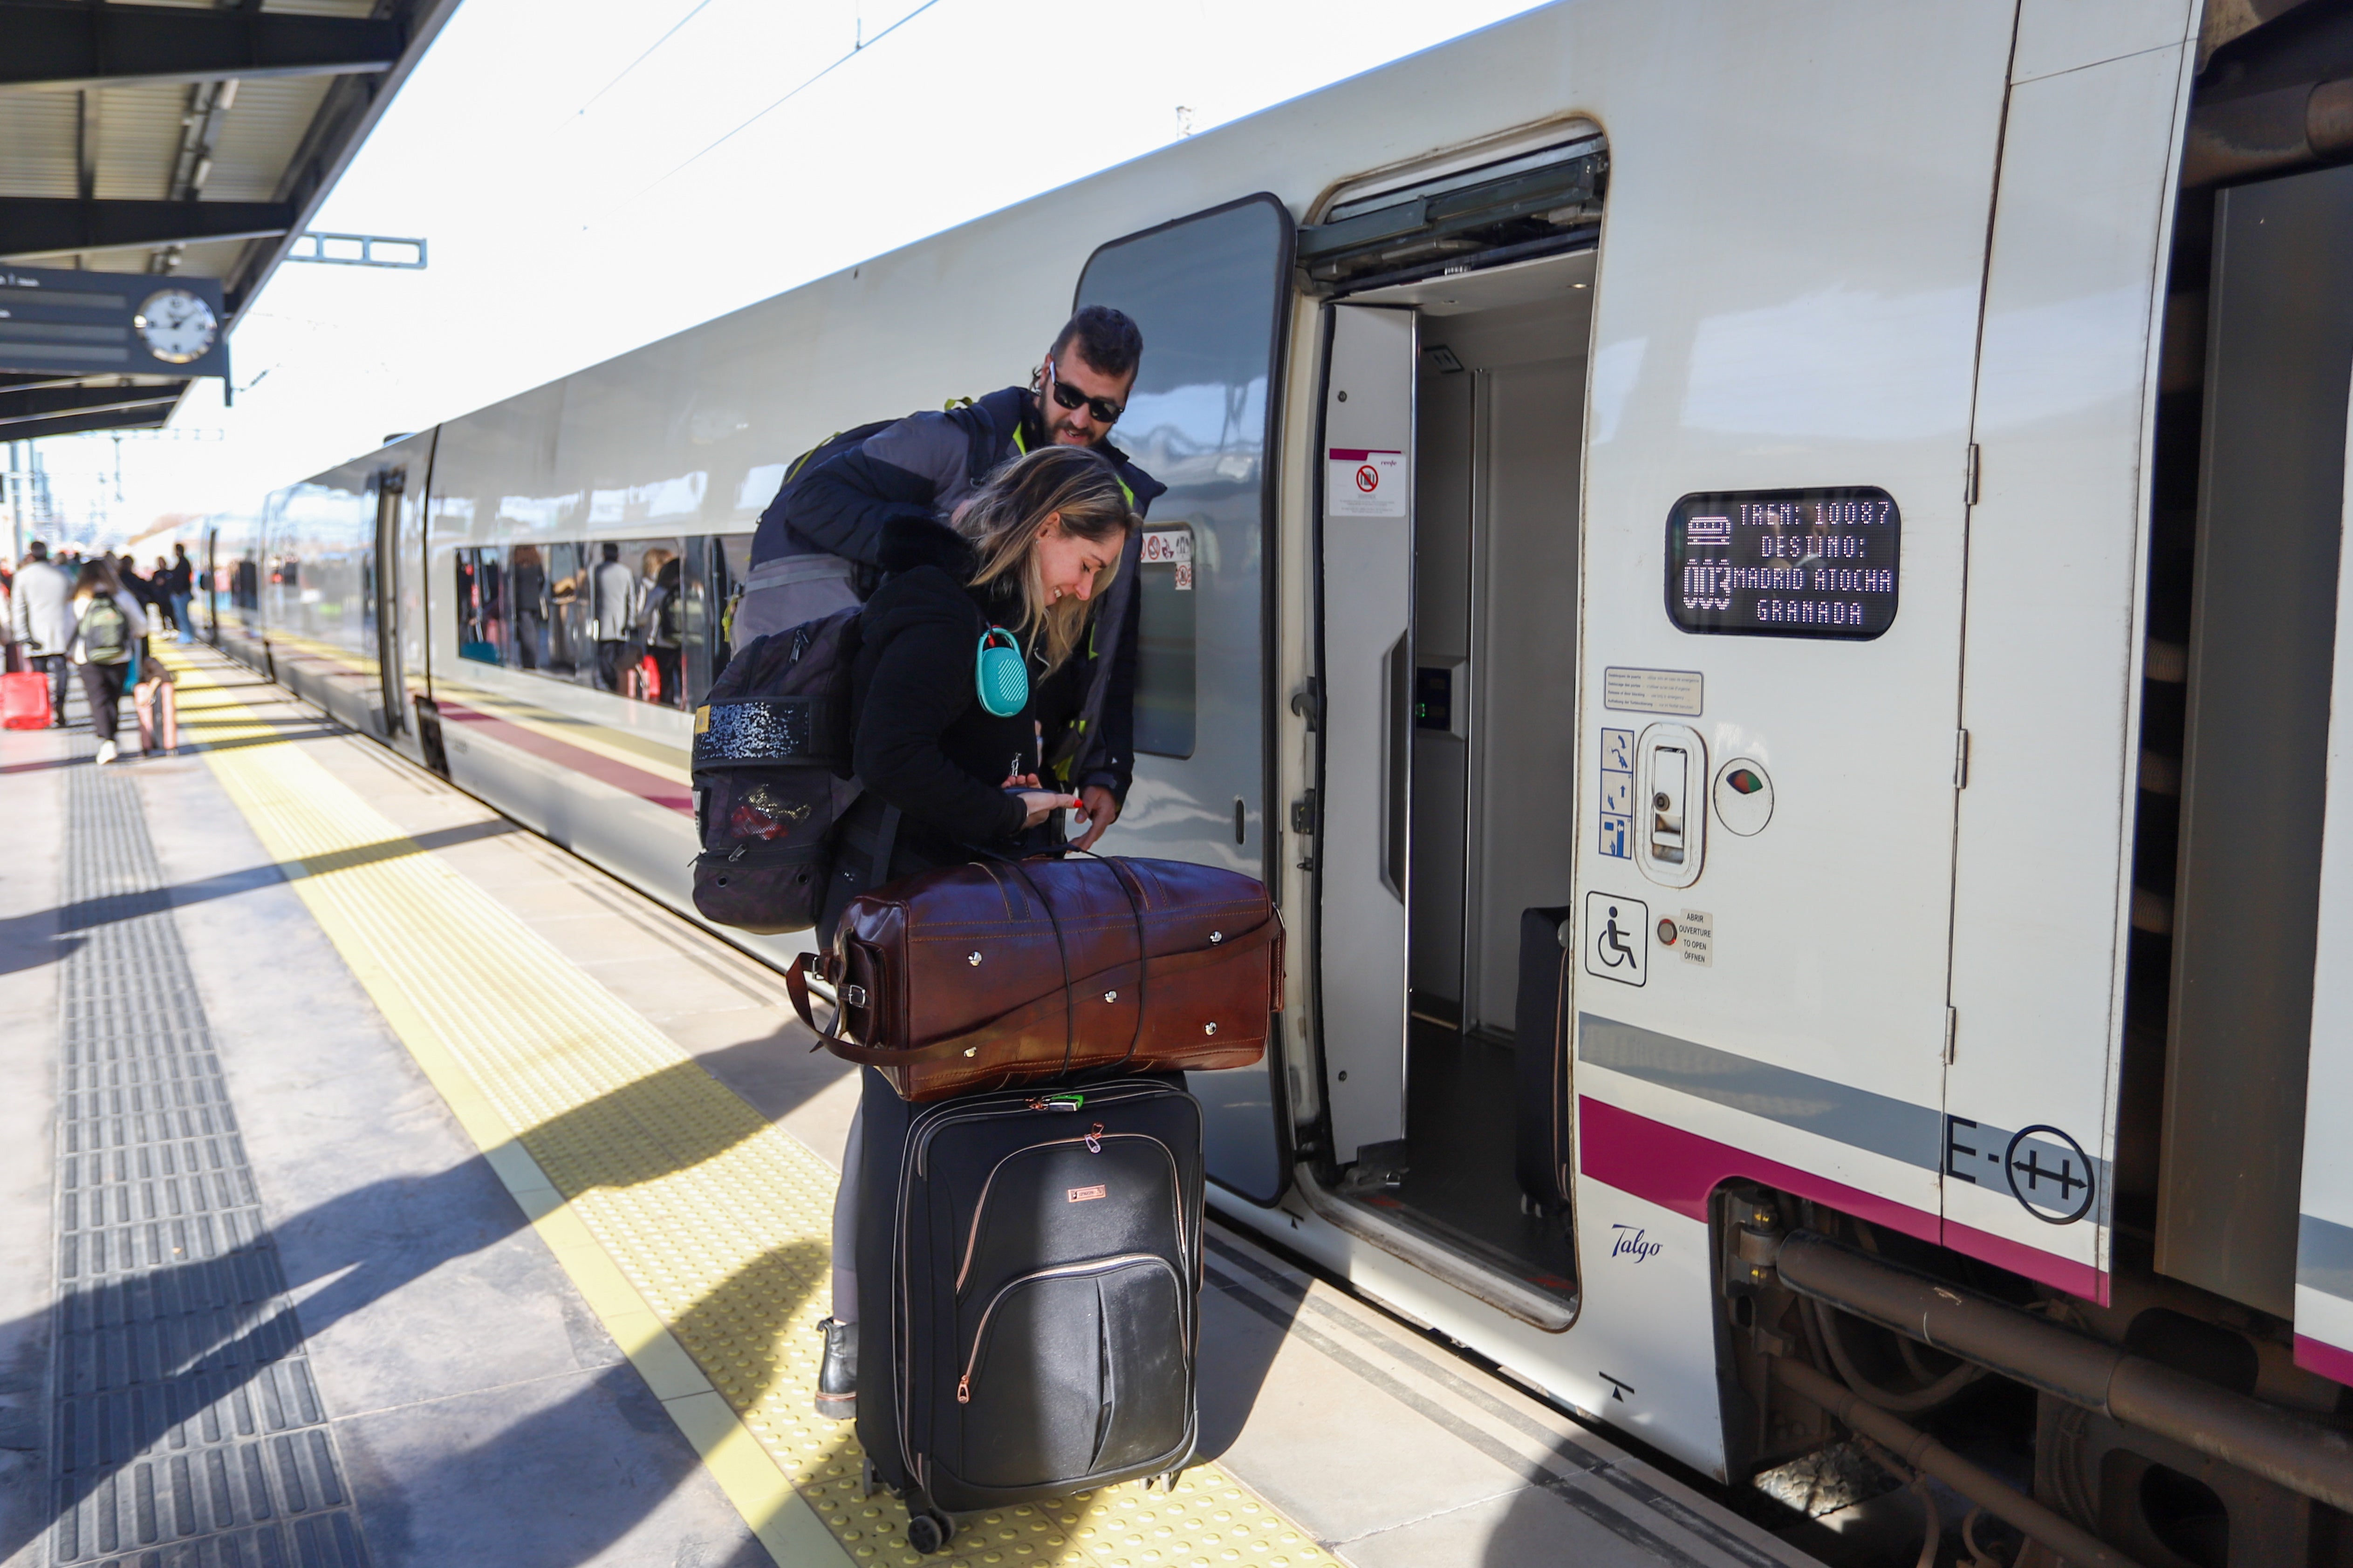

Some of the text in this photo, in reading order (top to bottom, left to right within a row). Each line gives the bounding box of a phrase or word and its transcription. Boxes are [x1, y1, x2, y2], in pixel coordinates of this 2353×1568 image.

[1740, 501, 1888, 525] TREN: 10087
[1761, 535, 1864, 558] DESTINO:
[1733, 567, 1891, 593] MADRID ATOCHA
[1757, 599, 1861, 625] GRANADA
[1686, 913, 1703, 923] ABRIR
[1679, 925, 1711, 938] OUVERTURE
[1683, 939, 1707, 951] TO OPEN
[1684, 950, 1705, 963] ÖFFNEN
[1611, 1224, 1663, 1264] Talgo
